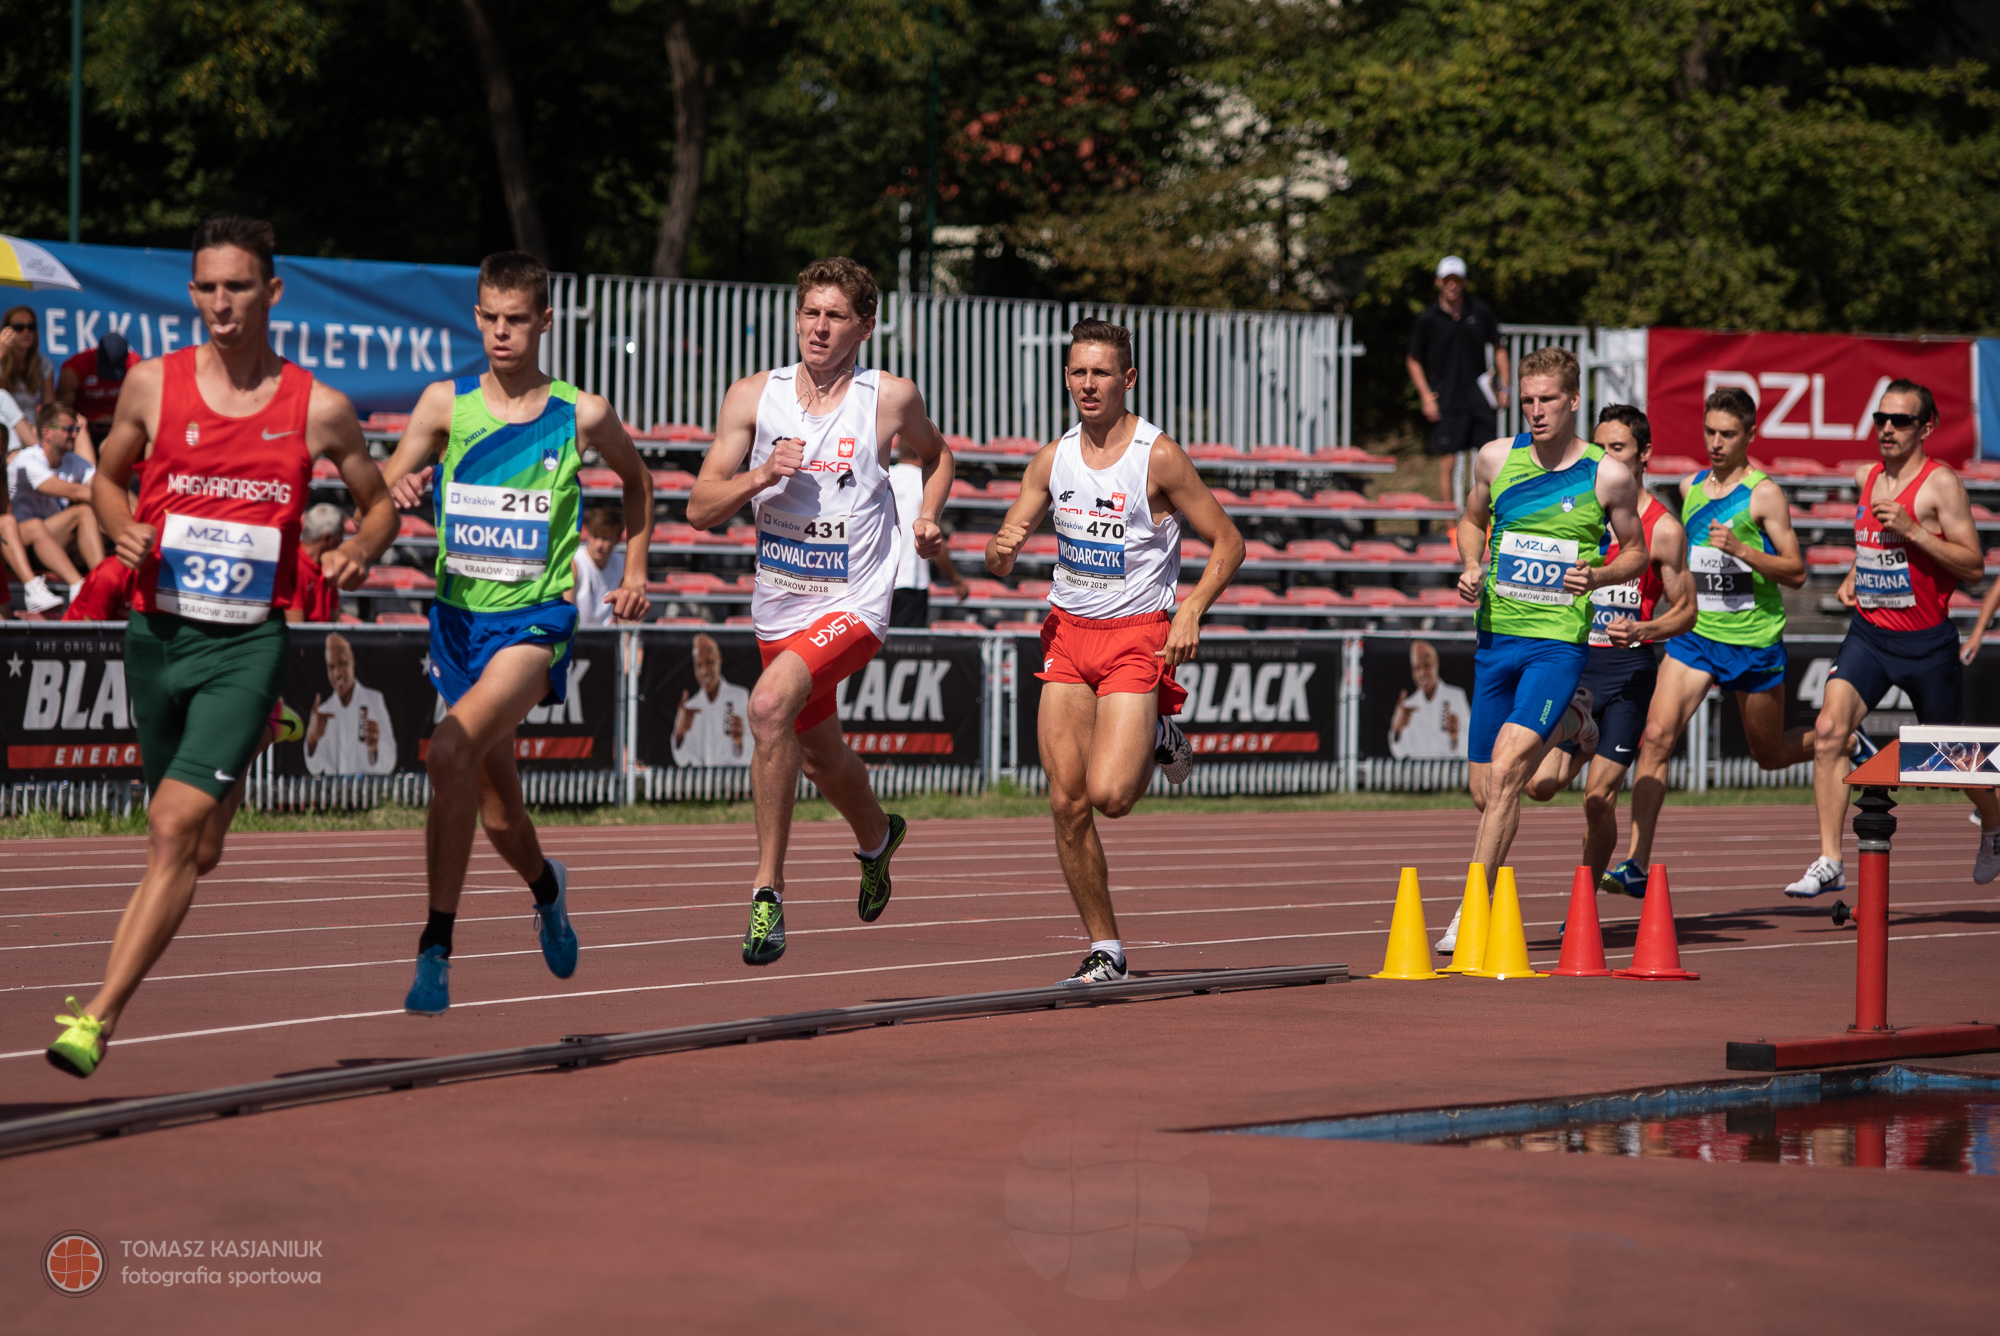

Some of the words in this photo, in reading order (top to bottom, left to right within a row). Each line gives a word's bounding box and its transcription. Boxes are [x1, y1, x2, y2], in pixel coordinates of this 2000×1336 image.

[269, 319, 453, 373] TLETYKI
[799, 460, 851, 473] LSKA
[167, 473, 292, 504] MAGYARORSZÁG
[1059, 490, 1075, 502] 4F
[463, 495, 496, 506] Kraków
[501, 493, 550, 514] 216
[187, 525, 254, 547] MZLA
[454, 523, 539, 550] KOKALJ
[773, 518, 801, 531] Kraków
[804, 521, 845, 539] 431
[1060, 519, 1084, 531] Kraków
[1086, 521, 1124, 539] 470
[762, 540, 845, 570] KOWALCZYK
[1058, 539, 1121, 568] WŁODARCZYK
[1515, 538, 1562, 554] MZLA
[1877, 551, 1906, 566] 150
[181, 555, 255, 594] 339
[464, 564, 502, 575] KRAKÓW
[505, 568, 526, 578] 2018
[1511, 559, 1561, 585] 209
[774, 577, 806, 591] KRAKÓW
[808, 585, 829, 593] 2018
[1090, 581, 1108, 589] 2018
[1705, 574, 1734, 591] 123
[1509, 591, 1540, 600] KRAKÓW
[1542, 594, 1559, 602] 2018
[1607, 589, 1639, 604] 119
[176, 602, 220, 617] KRAKÓW
[223, 609, 247, 620] 2018
[809, 612, 863, 647] OLSKA
[35, 641, 57, 653] THE
[64, 641, 122, 653] ORIGINAL
[23, 659, 138, 730] BLA
[836, 659, 952, 721] LACK
[1173, 663, 1316, 723] BLACK
[842, 734, 907, 751] ERGY
[1190, 734, 1274, 752] ENERGY
[55, 746, 136, 766] ENERG
